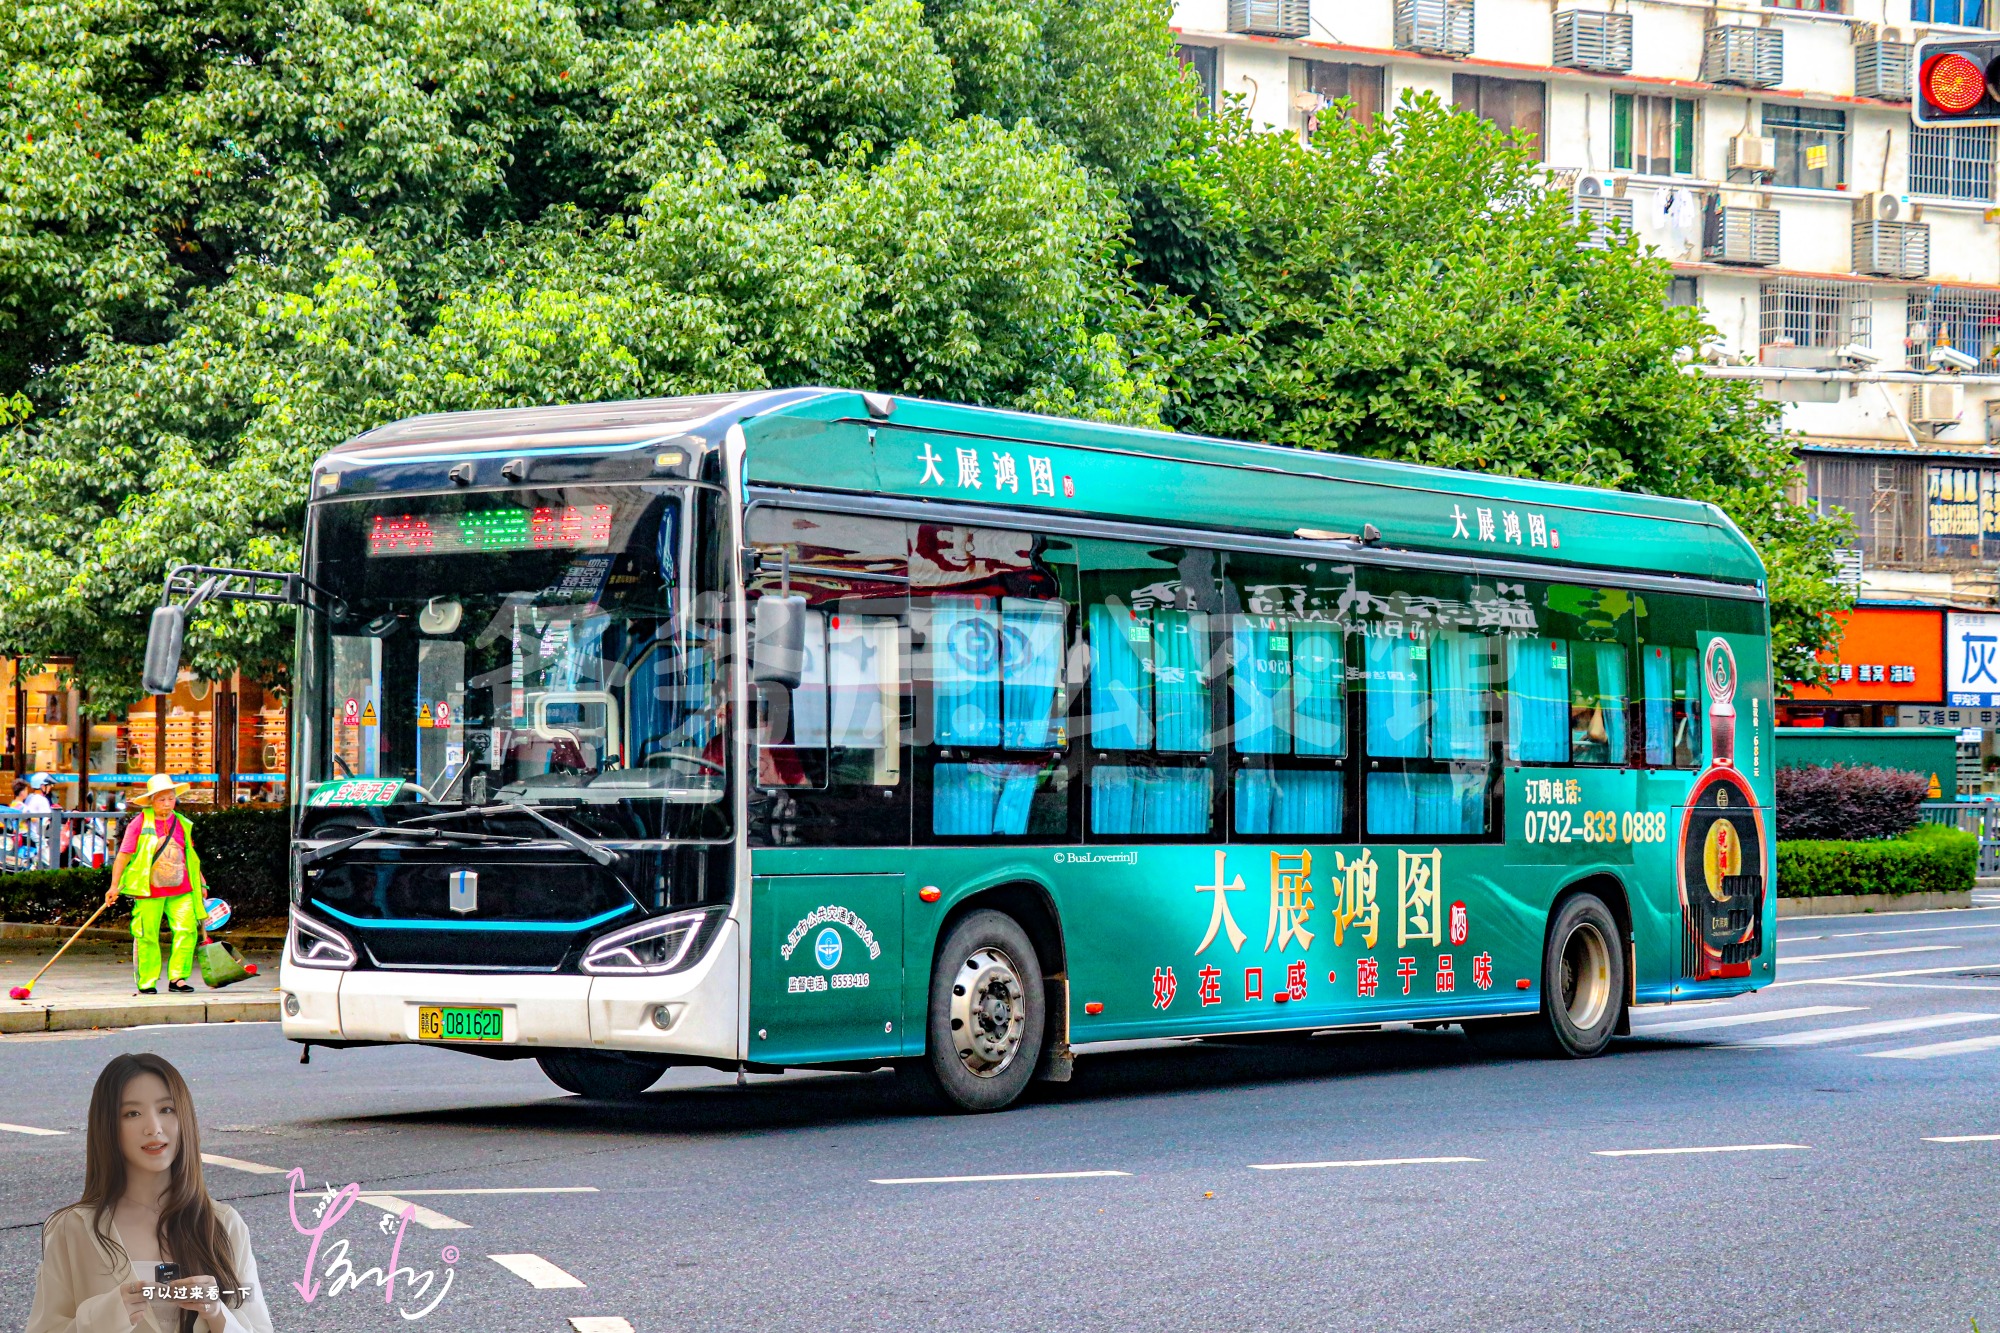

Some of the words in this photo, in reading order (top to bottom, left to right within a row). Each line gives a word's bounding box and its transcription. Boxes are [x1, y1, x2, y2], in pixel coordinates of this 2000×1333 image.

[917, 443, 1055, 498] 大展鸿图
[1449, 504, 1548, 549] 大展鸿图
[1962, 632, 1998, 684] 灰
[332, 782, 399, 802] 空调开启
[1524, 811, 1617, 844] 0792-833
[1622, 811, 1666, 844] 0888
[1194, 847, 1443, 956] 大展鸿图
